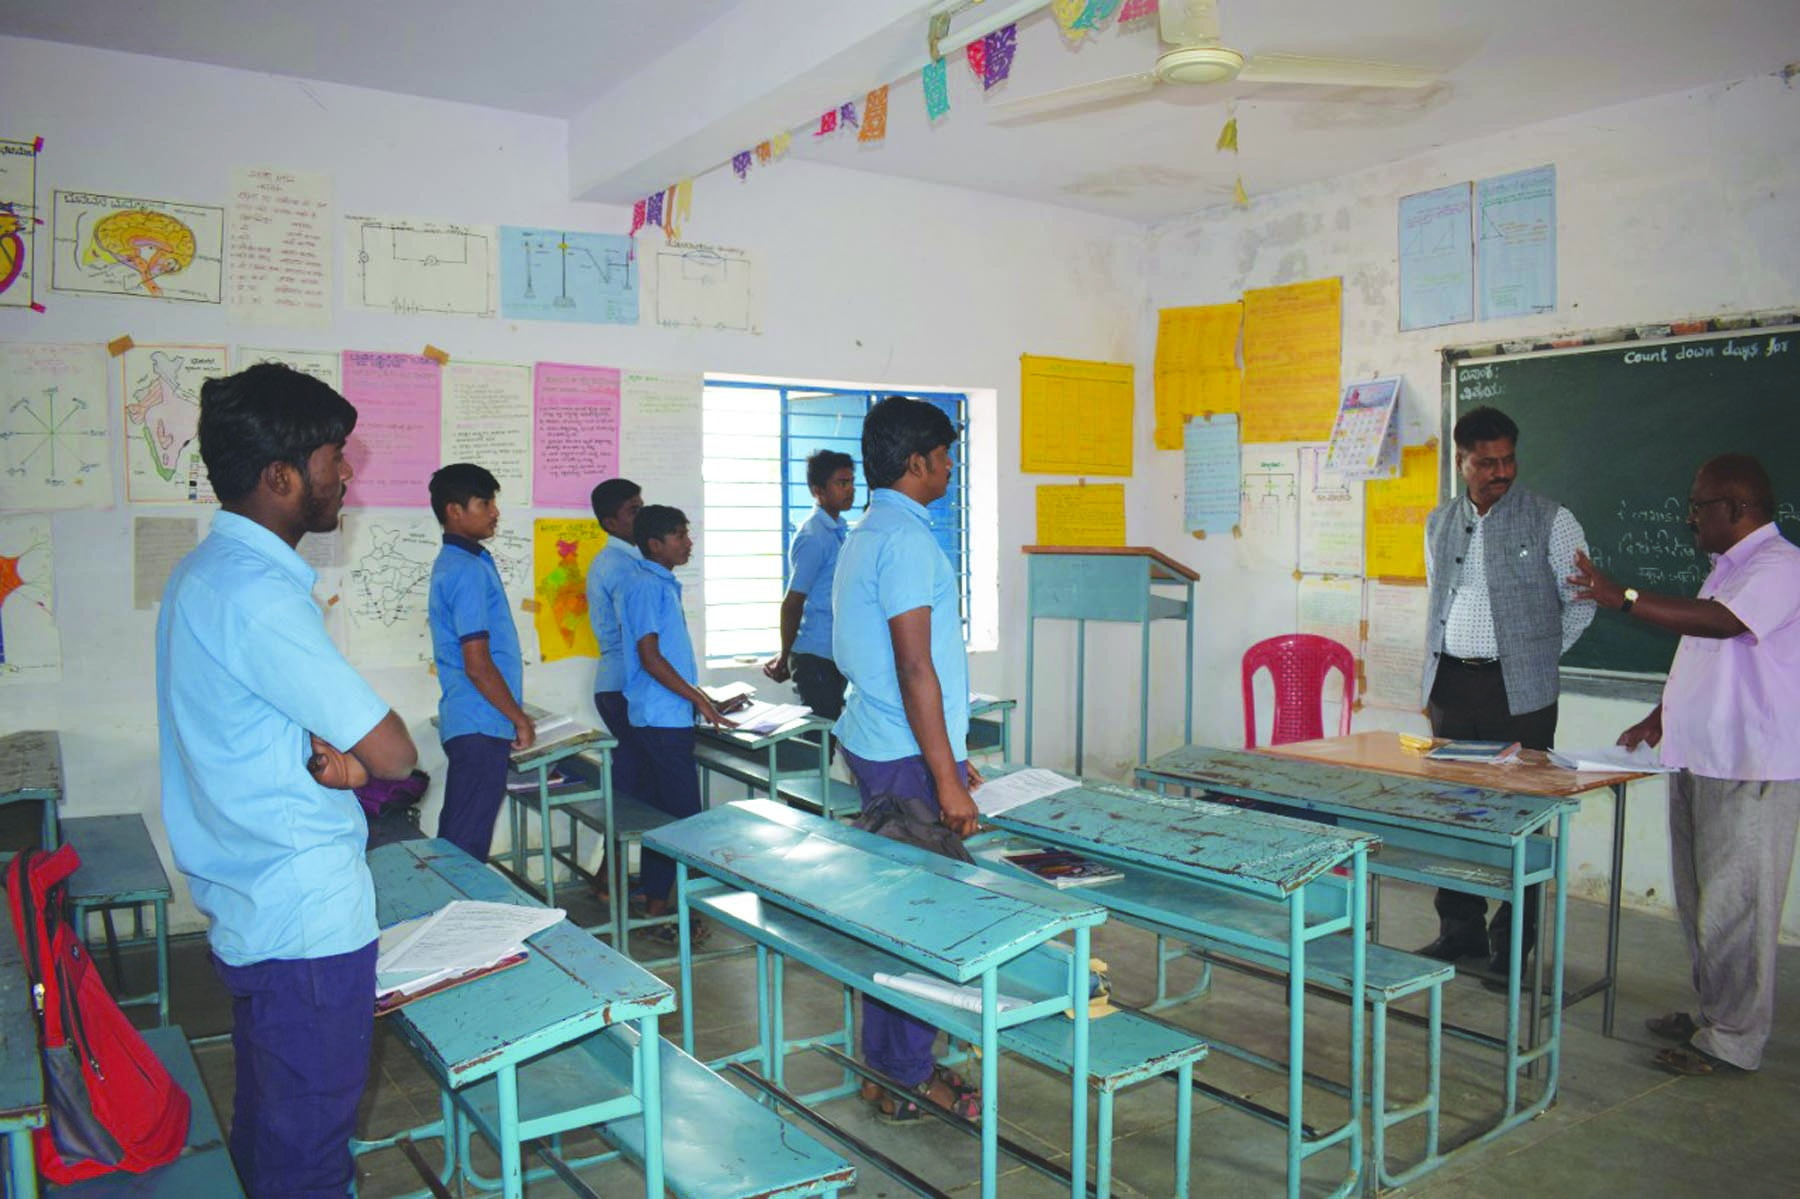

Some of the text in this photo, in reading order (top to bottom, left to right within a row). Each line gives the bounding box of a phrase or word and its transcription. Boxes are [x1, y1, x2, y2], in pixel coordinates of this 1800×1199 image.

[1675, 345, 1715, 361] down
[1722, 339, 1759, 361] days
[1766, 336, 1790, 357] for
